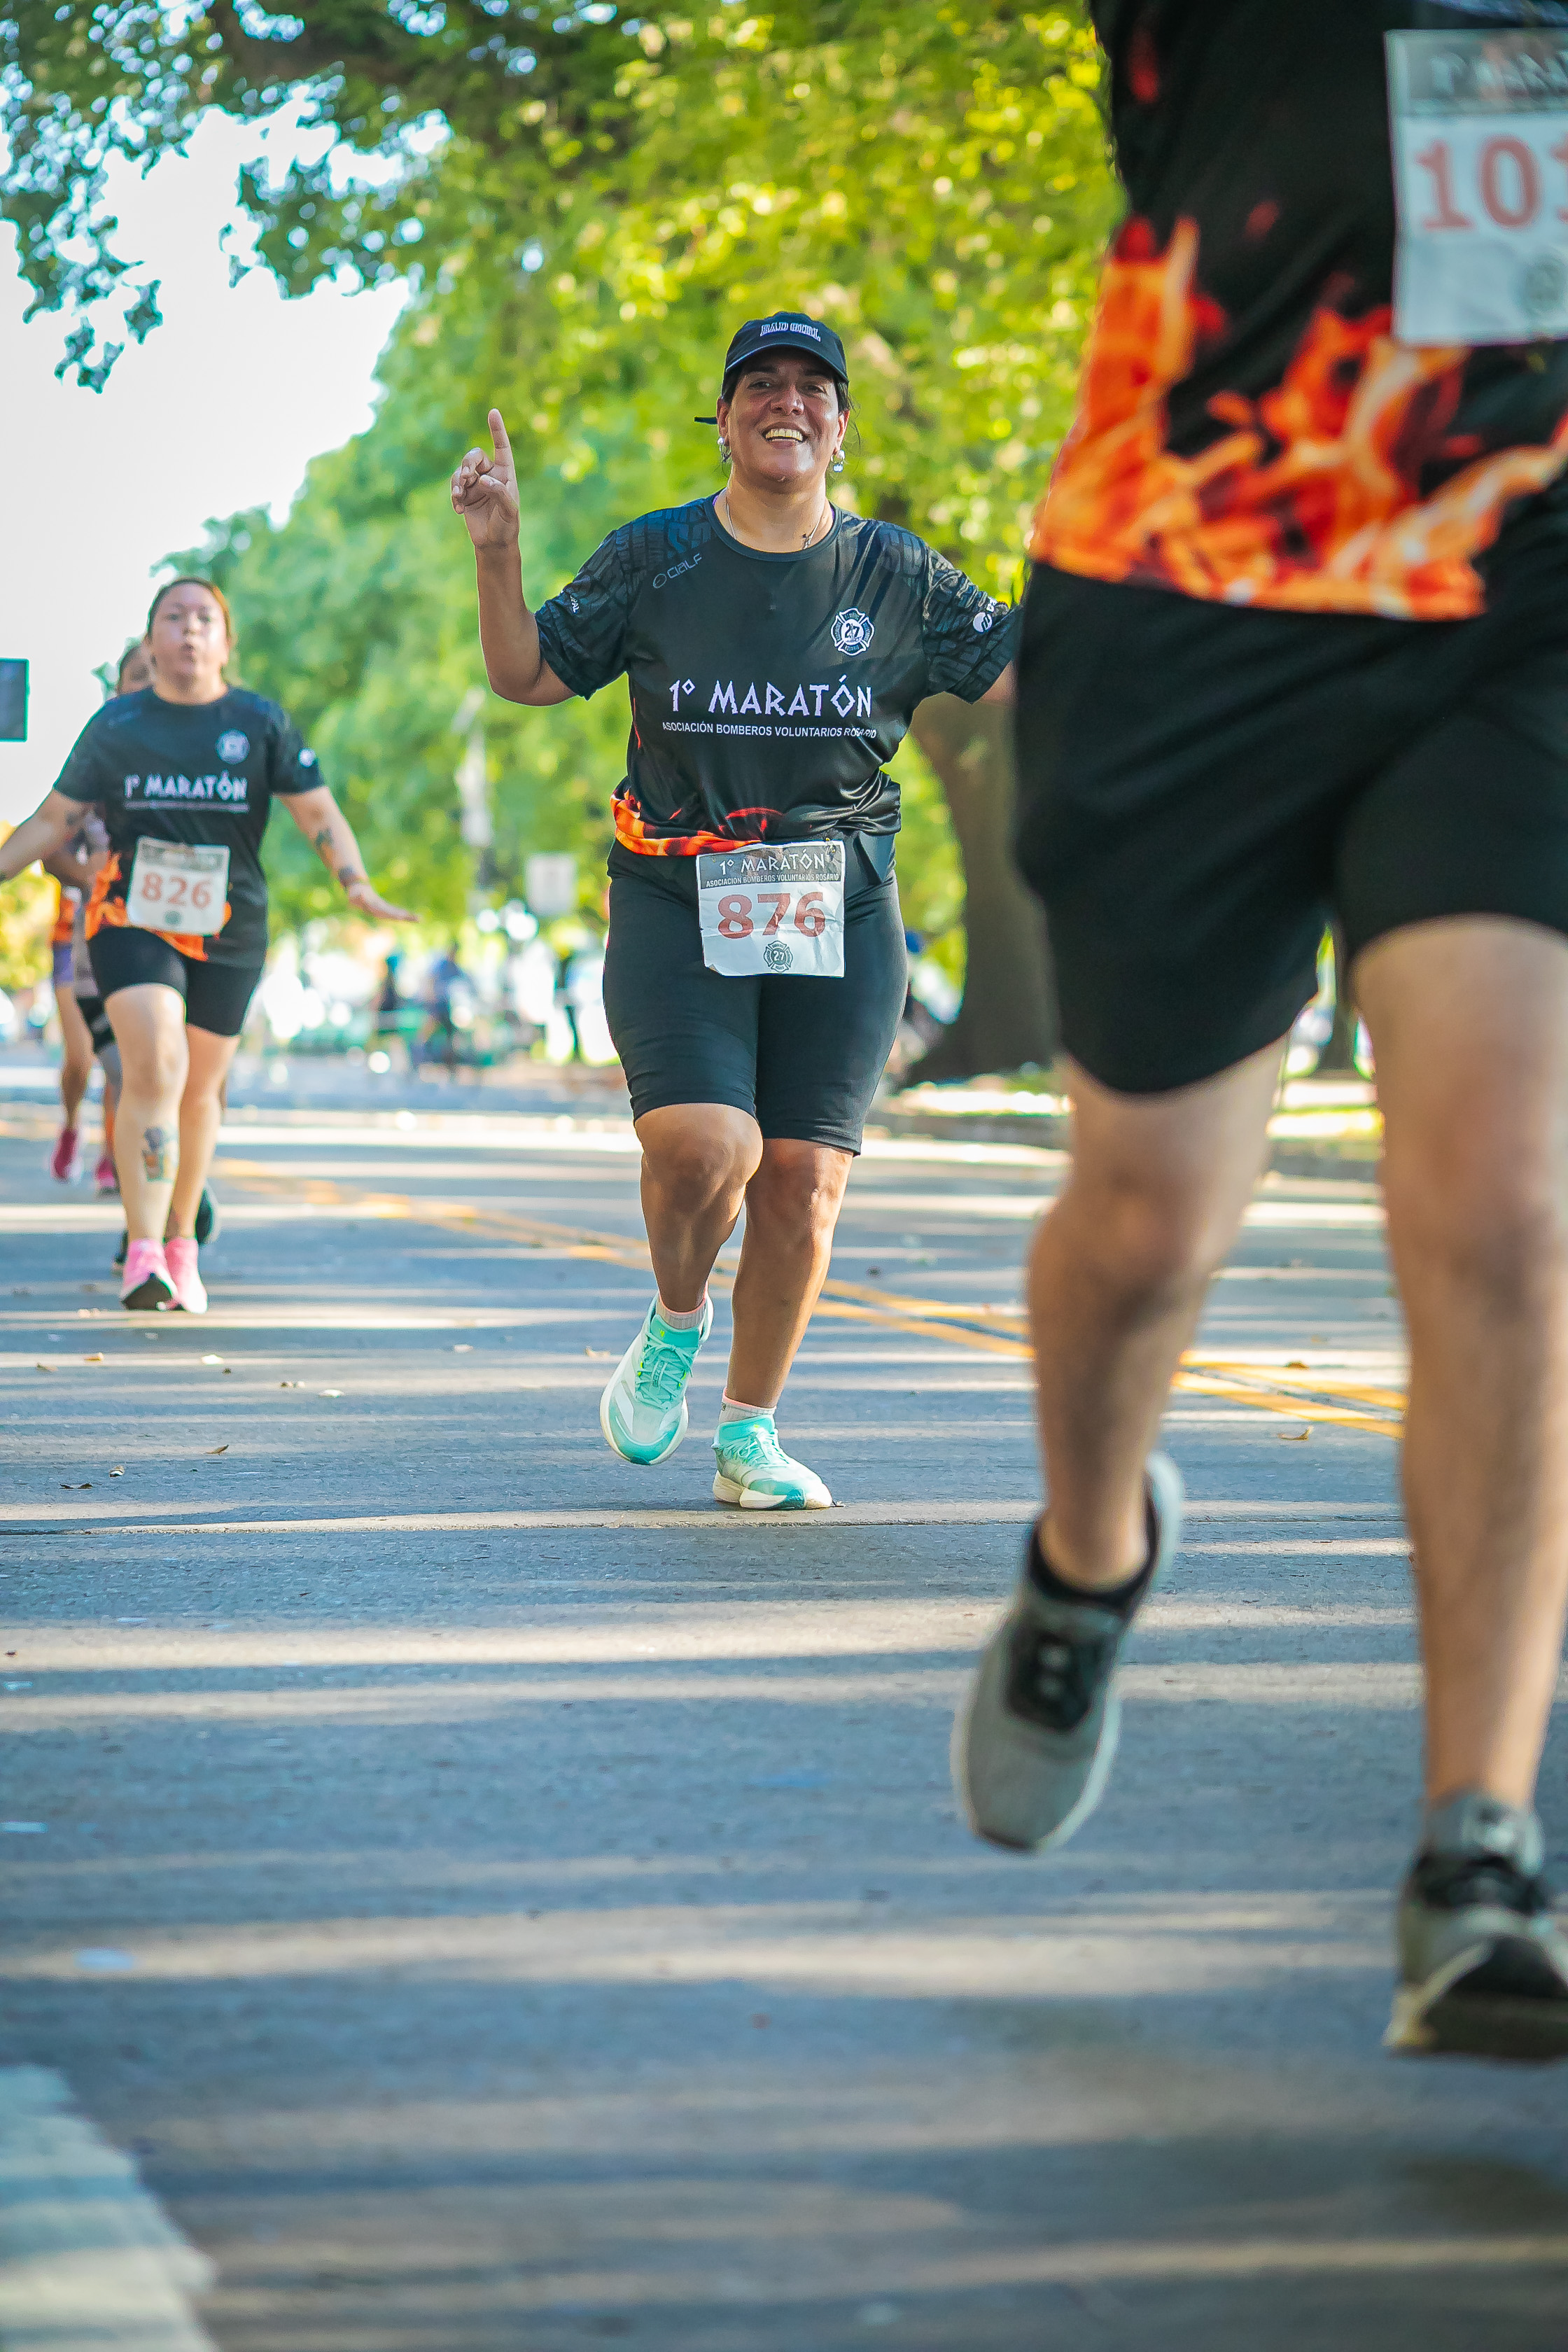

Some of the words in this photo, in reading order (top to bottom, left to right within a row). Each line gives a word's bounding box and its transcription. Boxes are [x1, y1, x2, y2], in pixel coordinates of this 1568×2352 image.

[708, 675, 872, 718] MARATÓN
[662, 720, 713, 734] ASOCIACIÓN
[716, 724, 772, 736] BOMBEROS
[774, 726, 842, 737] VOLUNTARIOS
[741, 848, 825, 873] MARATÓN
[142, 872, 211, 909] 826
[743, 875, 776, 883] BOMBEROS
[777, 874, 815, 882] VOLUNTARIOS
[816, 873, 839, 881] ROSARIO
[718, 891, 826, 939] 876
